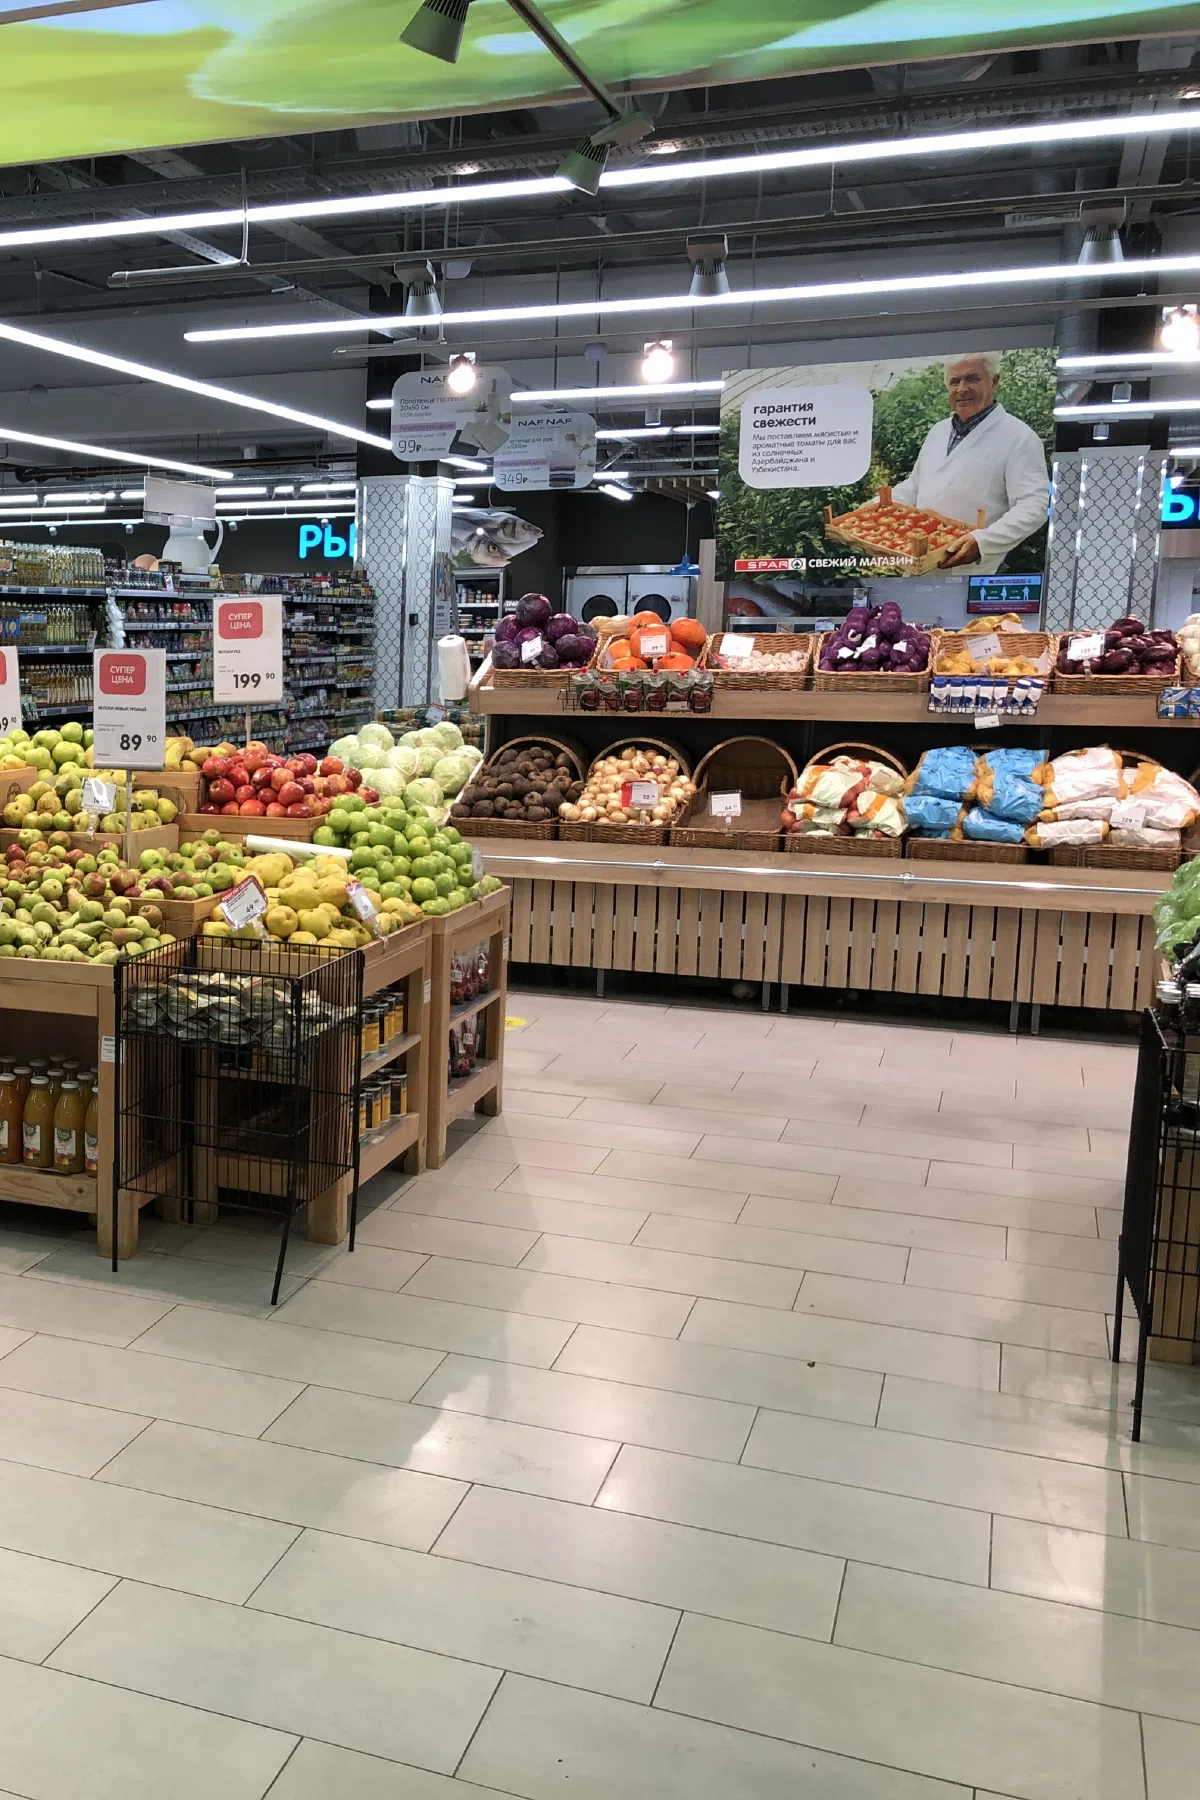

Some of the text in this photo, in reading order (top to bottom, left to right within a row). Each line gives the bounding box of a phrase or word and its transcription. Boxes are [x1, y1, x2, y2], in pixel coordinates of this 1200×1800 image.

[753, 402, 814, 416] гарантия
[518, 417, 572, 427] NAF NAF
[752, 416, 816, 428] свежести
[767, 432, 812, 440] поставляем
[813, 430, 851, 438] мясистые
[752, 441, 795, 450] ароматные
[796, 439, 825, 447] томаты
[751, 457, 809, 466] Азербайджана
[751, 465, 800, 473] Узбекистана.
[747, 560, 788, 570] SPAR
[808, 555, 914, 568] СВЕЖИЙ МАГАЗИН
[228, 612, 253, 621] СУПЕР
[230, 621, 252, 630] ЦЕНА
[109, 665, 136, 674] СУПЕР
[111, 675, 134, 684] ЦЕНА
[233, 672, 275, 689] 199 90
[120, 733, 157, 751] 89 90
